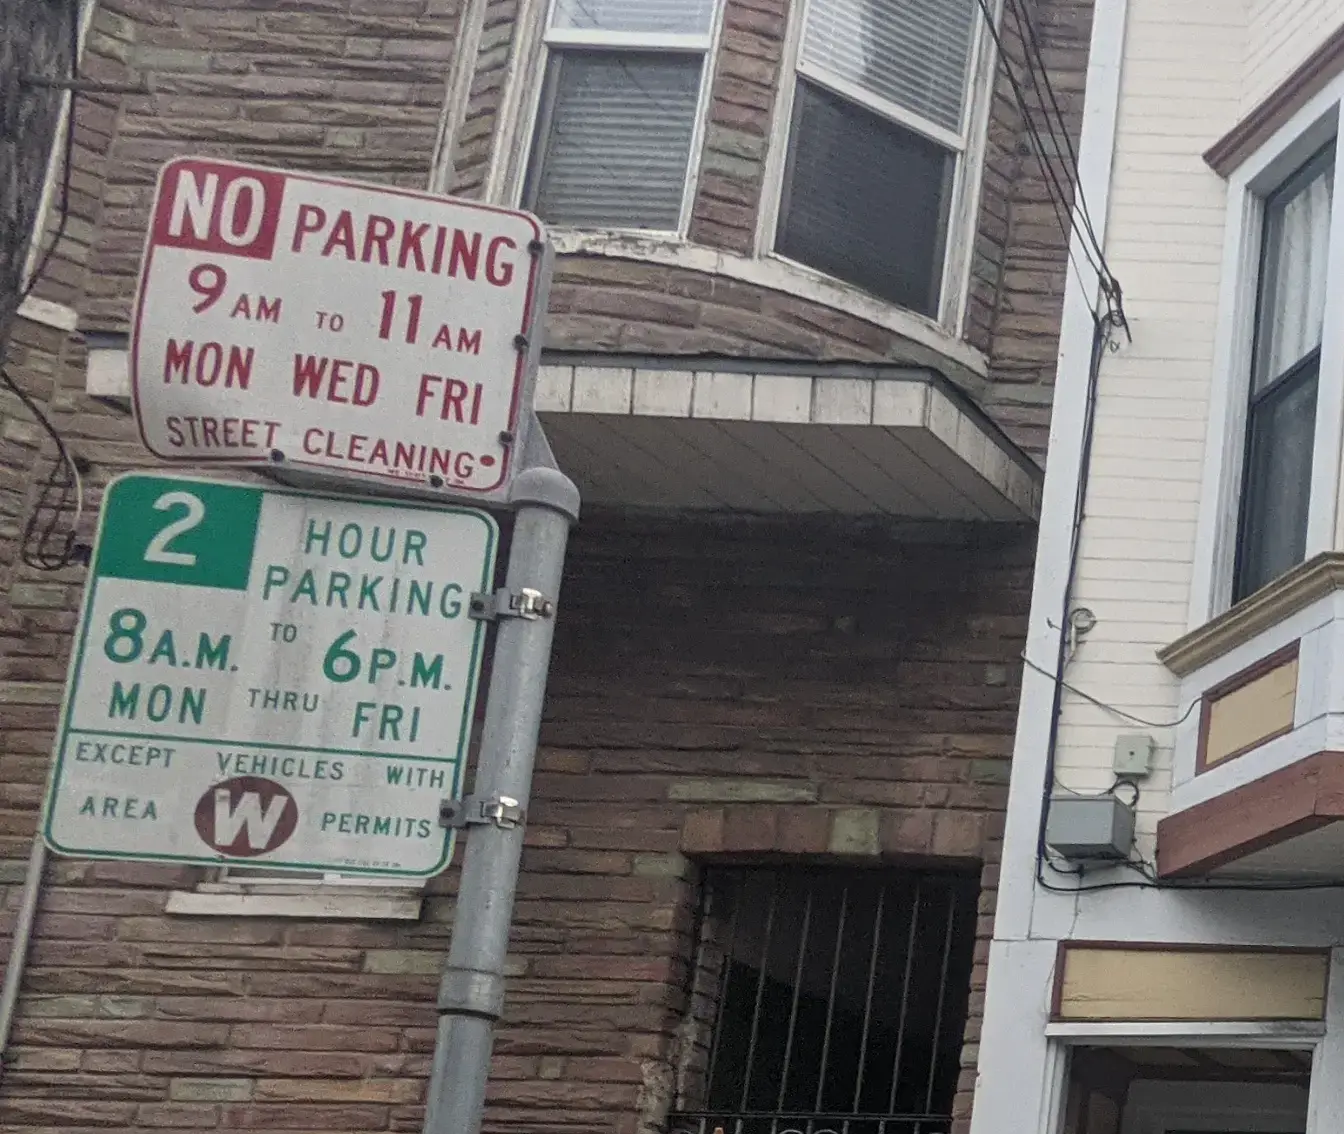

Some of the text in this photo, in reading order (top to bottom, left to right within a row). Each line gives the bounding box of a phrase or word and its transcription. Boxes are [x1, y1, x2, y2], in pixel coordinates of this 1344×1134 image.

[169, 170, 517, 287] NO PARKING
[316, 311, 345, 333] TO
[164, 340, 483, 425] MON WED FRI
[166, 416, 476, 479] STREET CLEANING
[143, 490, 206, 567] 2
[304, 519, 429, 566] HOUR
[263, 565, 463, 620] PARKING
[271, 622, 298, 645] TO
[108, 681, 421, 743] MON THRU FRI
[76, 741, 446, 789] EXCEPT VEHICLES WITH
[80, 789, 432, 850] AREA W PERMITS
